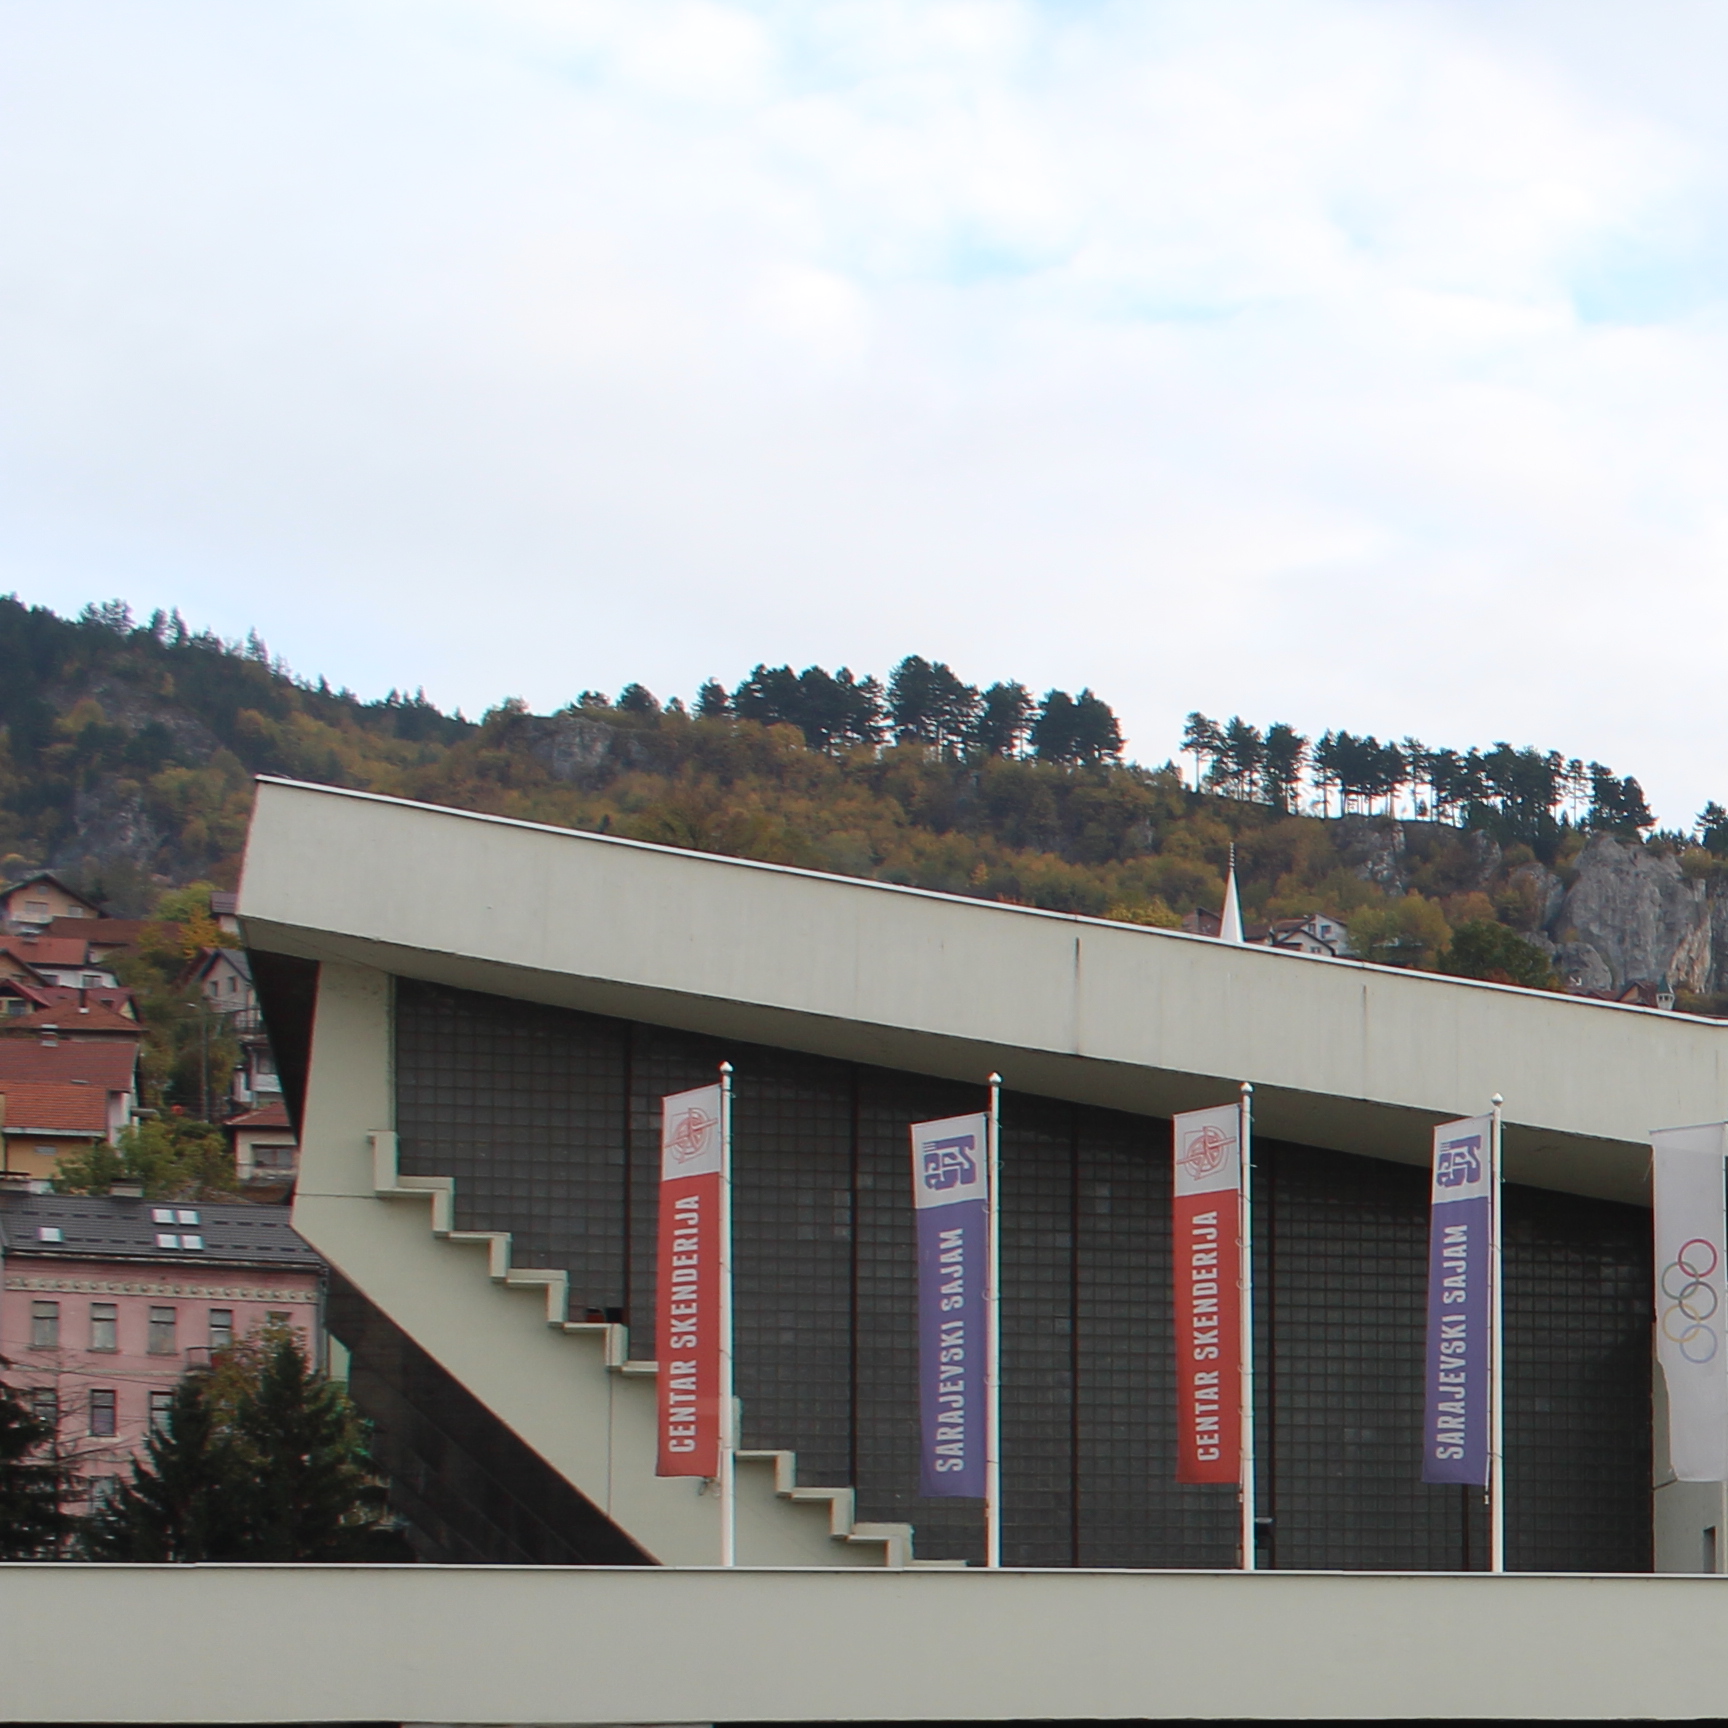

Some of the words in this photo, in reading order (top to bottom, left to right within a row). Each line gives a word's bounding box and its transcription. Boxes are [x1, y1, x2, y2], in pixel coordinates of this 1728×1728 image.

[669, 1194, 700, 1349] SKENDERIJA
[938, 1227, 964, 1311] SAJAM
[1191, 1209, 1219, 1360] SKENDERIJA
[1442, 1223, 1468, 1304] SAJAM
[668, 1356, 698, 1453] CENTAR
[935, 1320, 965, 1473] SARAJEVSKI
[1193, 1369, 1221, 1462] CENTAR
[1435, 1312, 1467, 1460] SARAJEVSKI
